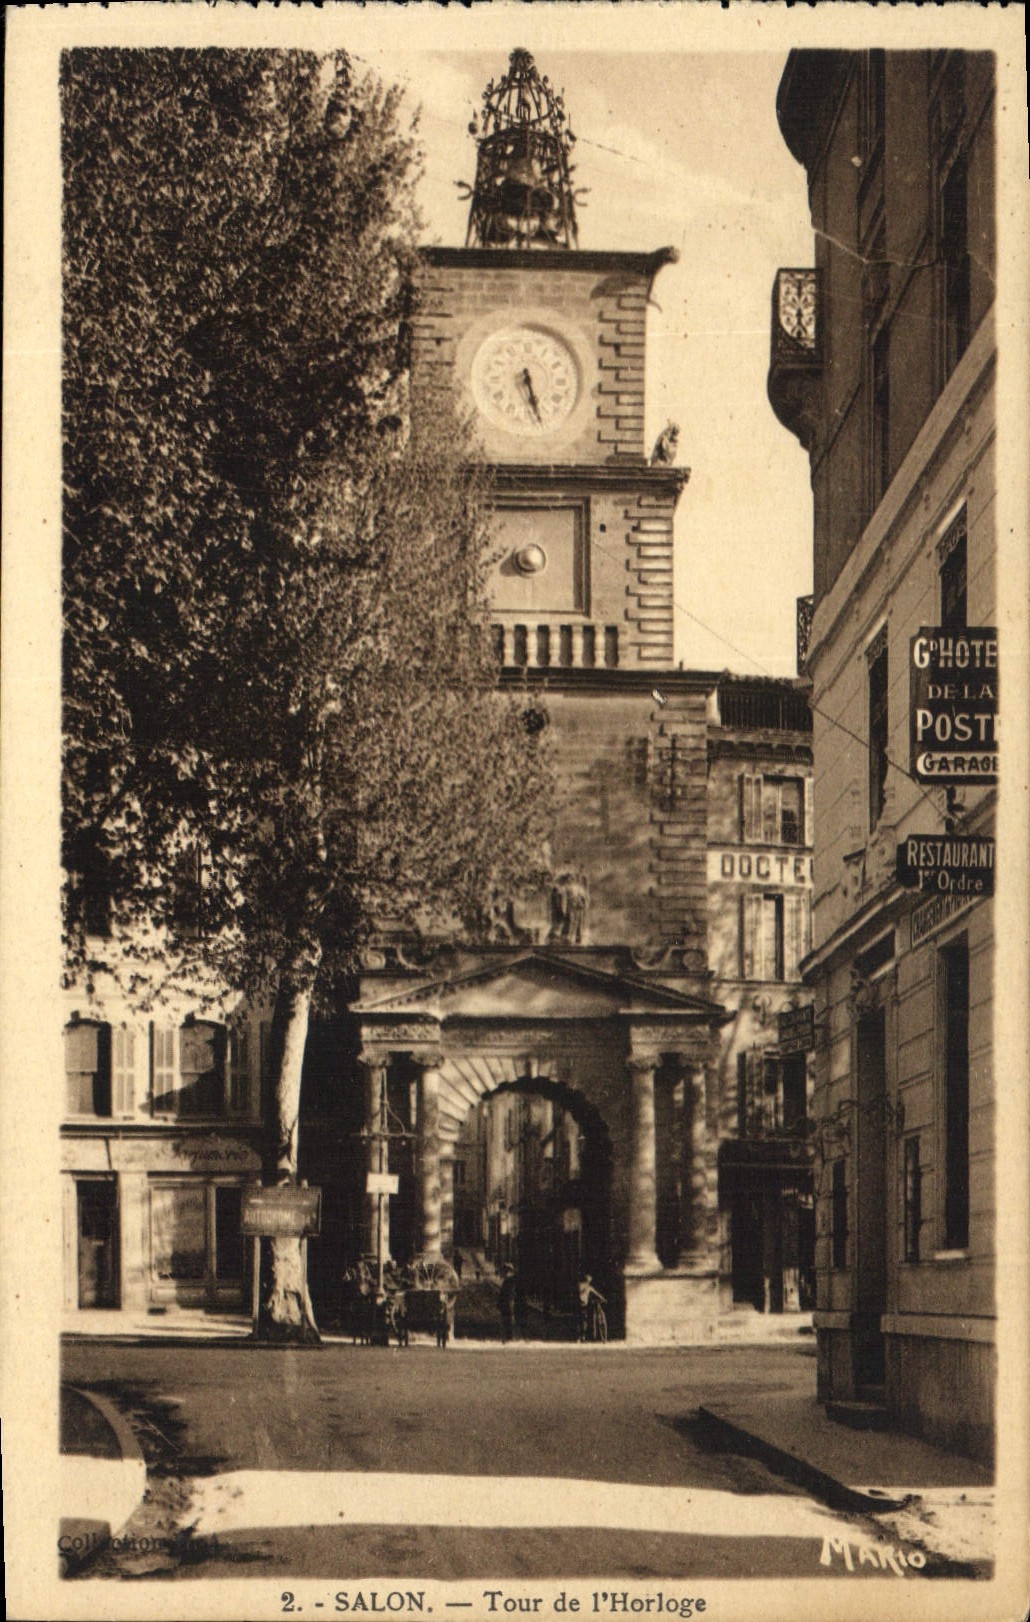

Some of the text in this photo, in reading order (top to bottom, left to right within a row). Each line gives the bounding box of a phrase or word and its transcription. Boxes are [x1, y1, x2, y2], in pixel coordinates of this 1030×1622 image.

[928, 684, 995, 699] DE LA
[907, 840, 995, 868] RESTAURANT
[721, 854, 814, 884] DOCTE
[937, 869, 983, 891] Ordre
